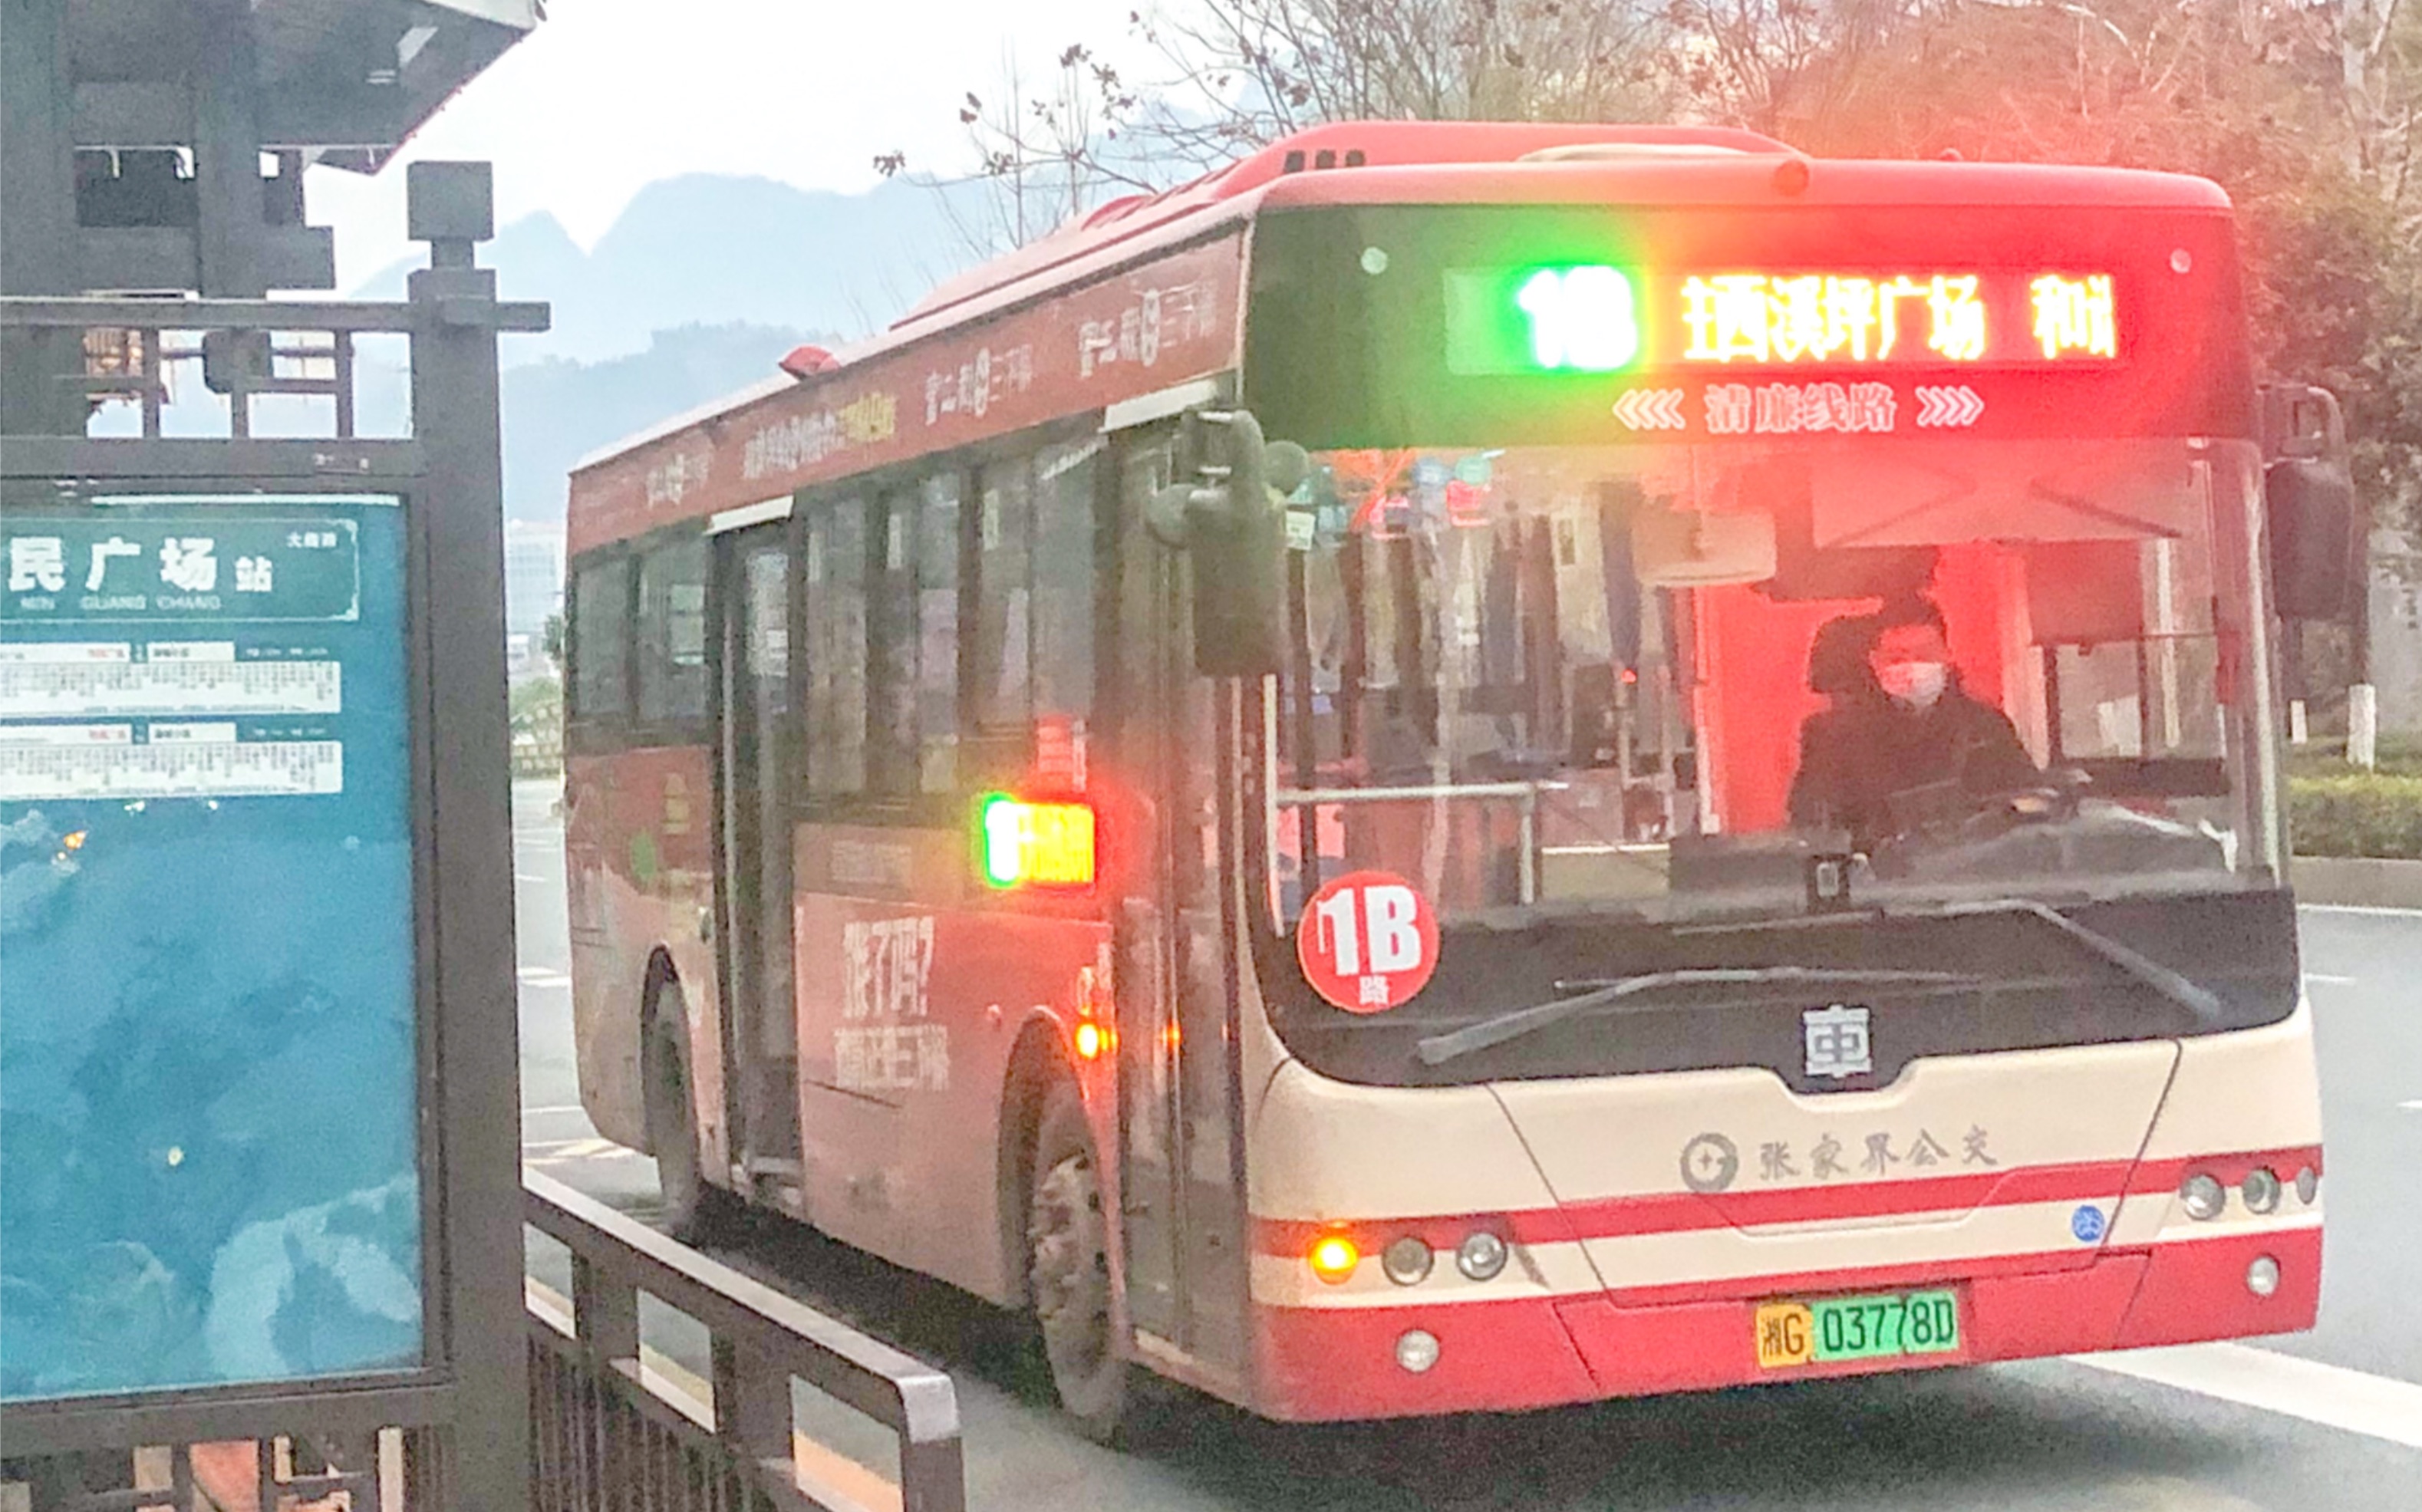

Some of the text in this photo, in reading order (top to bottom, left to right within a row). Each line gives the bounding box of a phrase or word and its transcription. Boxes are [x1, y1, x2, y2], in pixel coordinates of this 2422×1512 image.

[1704, 381, 1897, 434] 清廉线路
[1316, 884, 1422, 976] 1B
[1359, 974, 1390, 1006] 路
[1758, 1125, 1999, 1182] 张家界公交
[1822, 1299, 1956, 1352] 03778D
